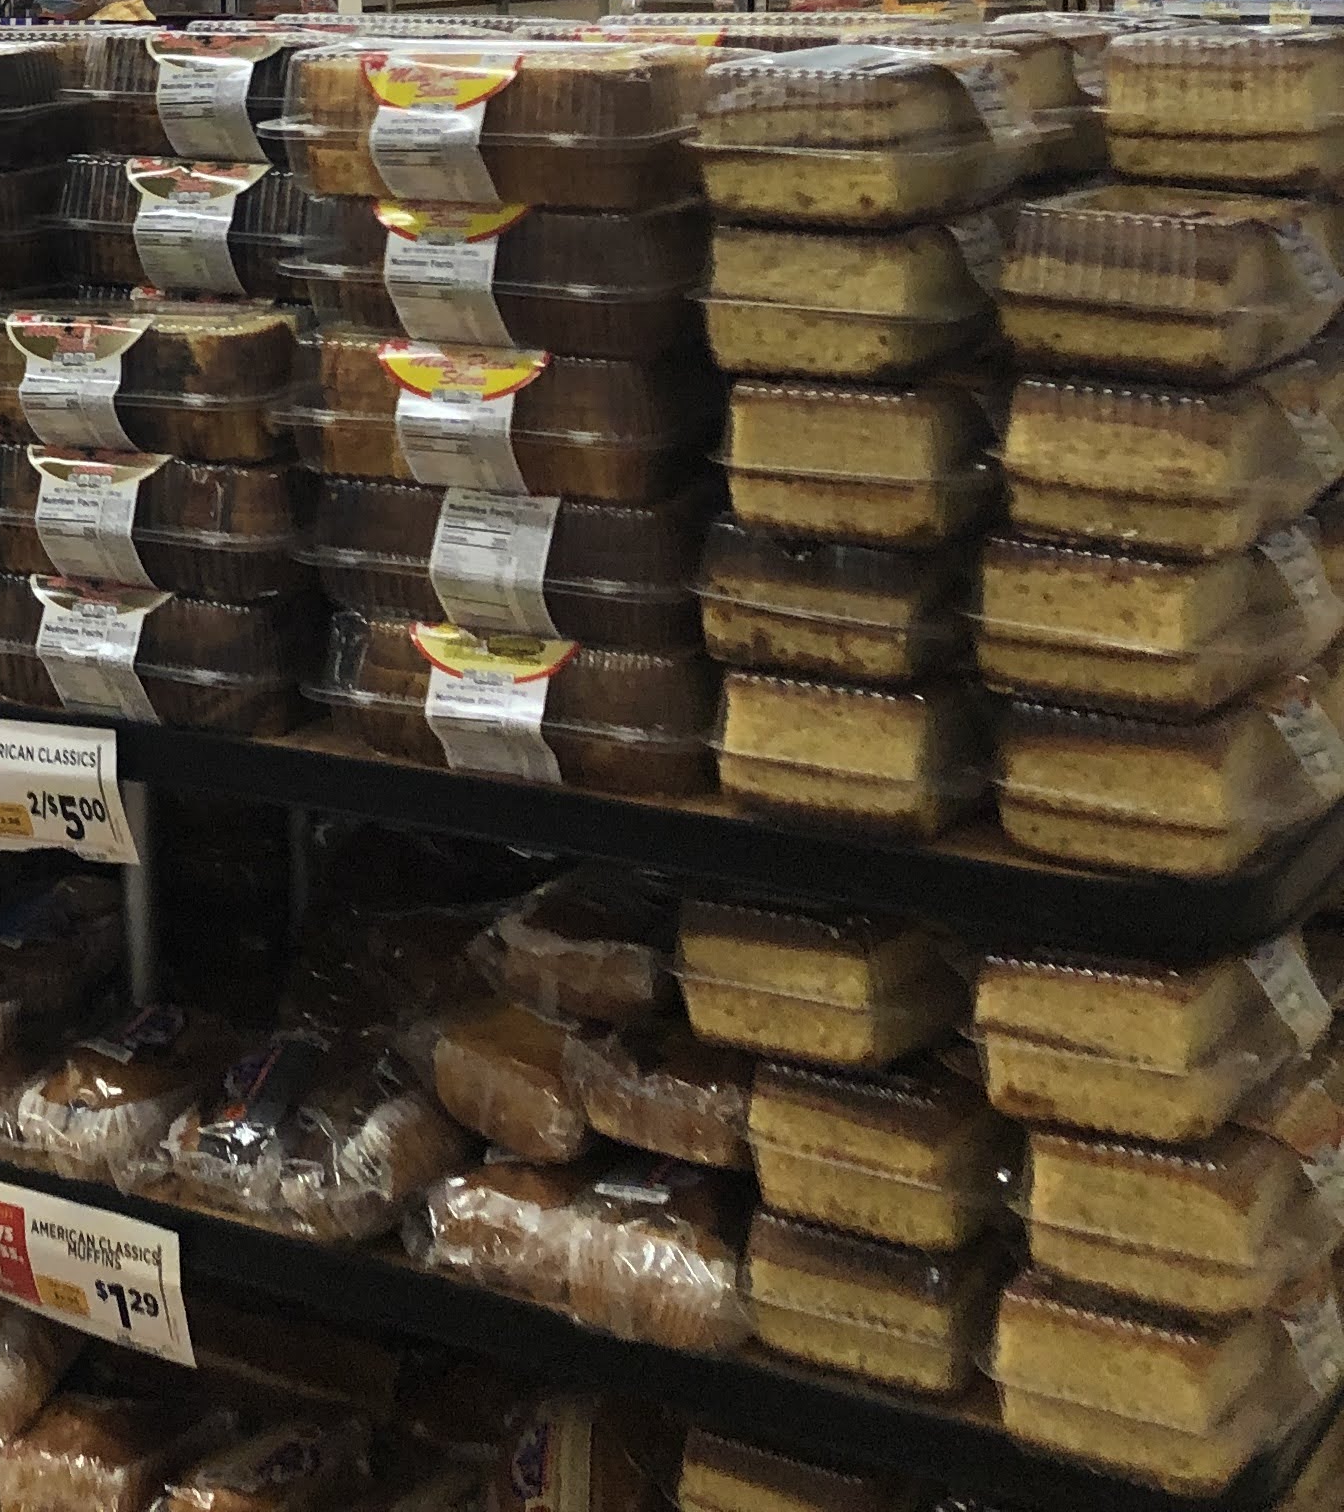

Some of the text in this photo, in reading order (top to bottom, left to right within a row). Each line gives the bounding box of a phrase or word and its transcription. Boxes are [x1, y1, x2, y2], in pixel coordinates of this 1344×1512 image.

[38, 746, 97, 769] CLASSICS
[31, 1219, 160, 1267] AMERICAN CLASSICS
[67, 1240, 123, 1271] MUFFINS
[95, 1278, 160, 1331] $129
